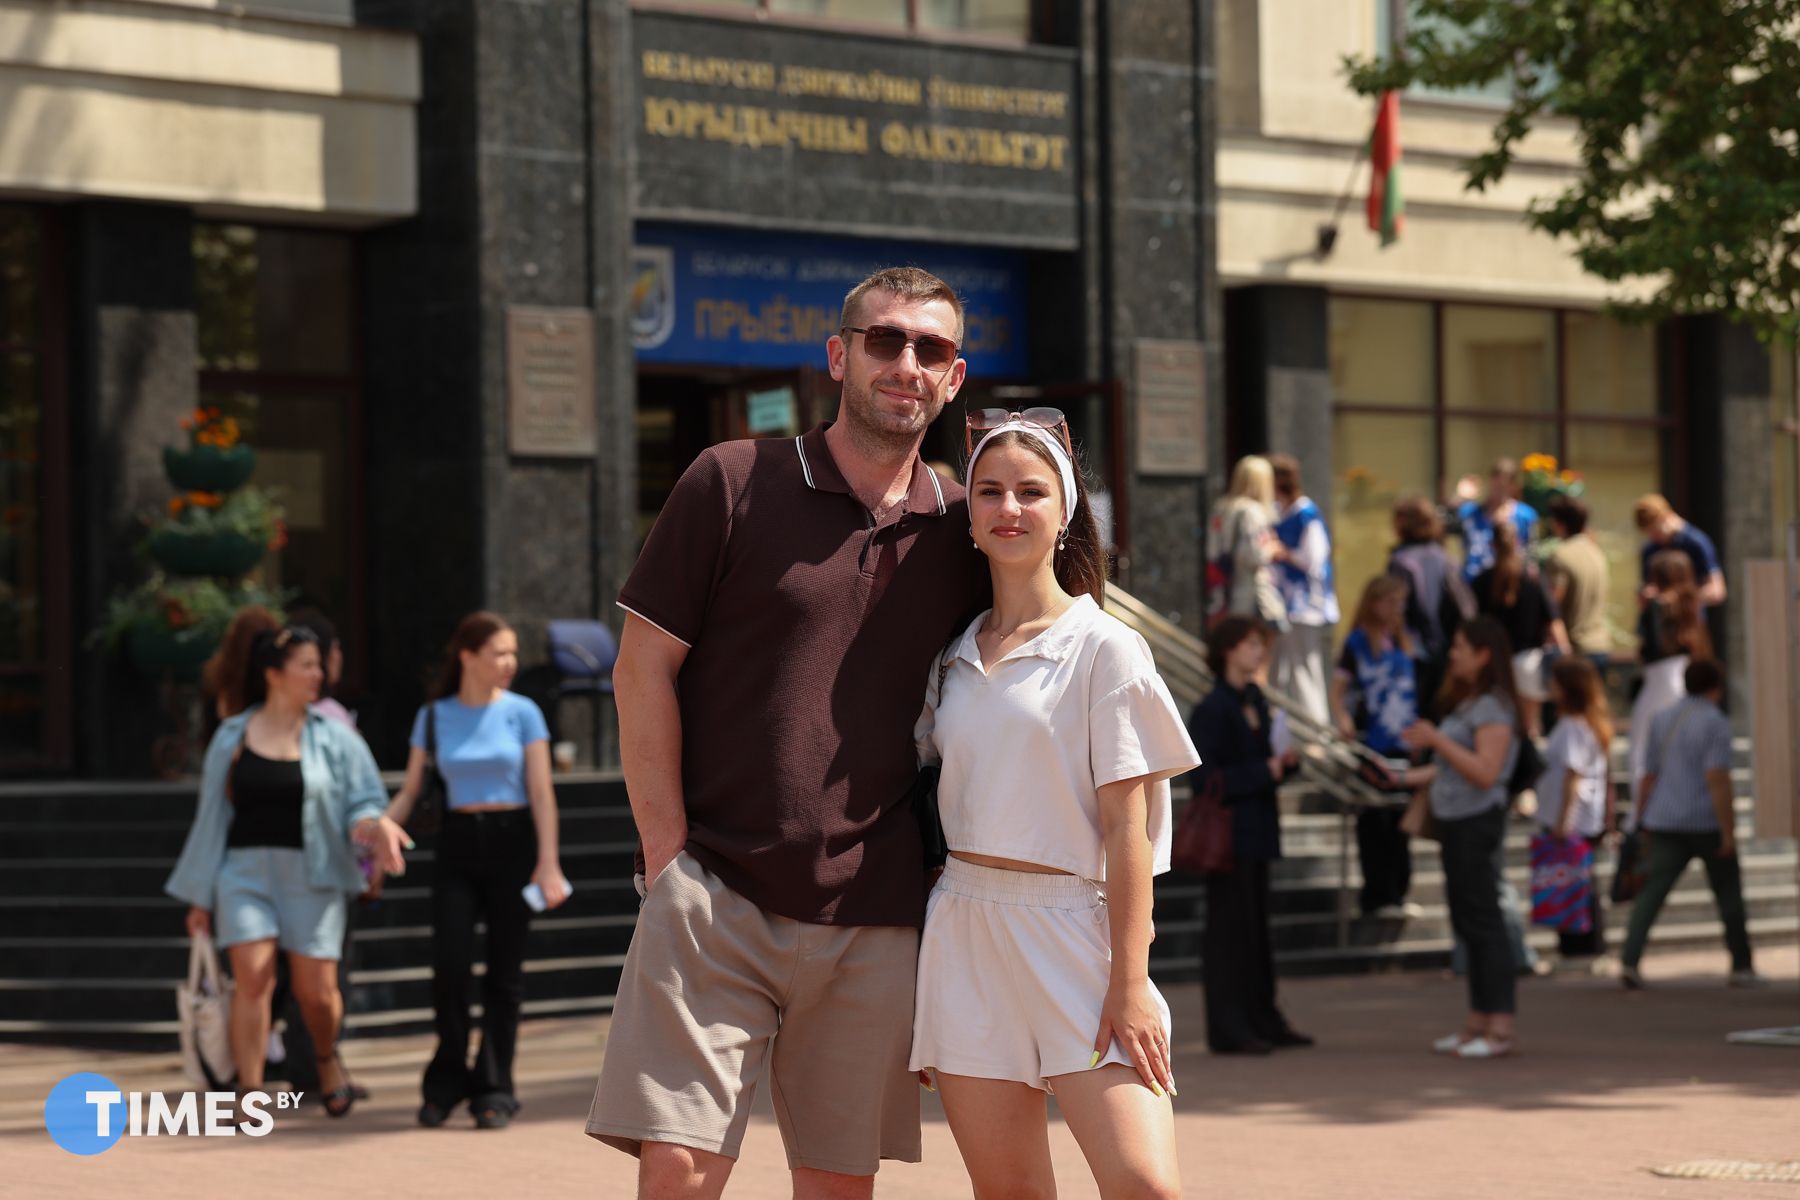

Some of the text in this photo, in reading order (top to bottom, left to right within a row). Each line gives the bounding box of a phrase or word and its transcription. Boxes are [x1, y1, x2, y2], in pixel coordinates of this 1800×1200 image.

[644, 96, 1069, 171] ЮРЫДЫЧНЫ ФАКУЛЬТЭТ
[695, 294, 842, 345] ПРЫЁМН
